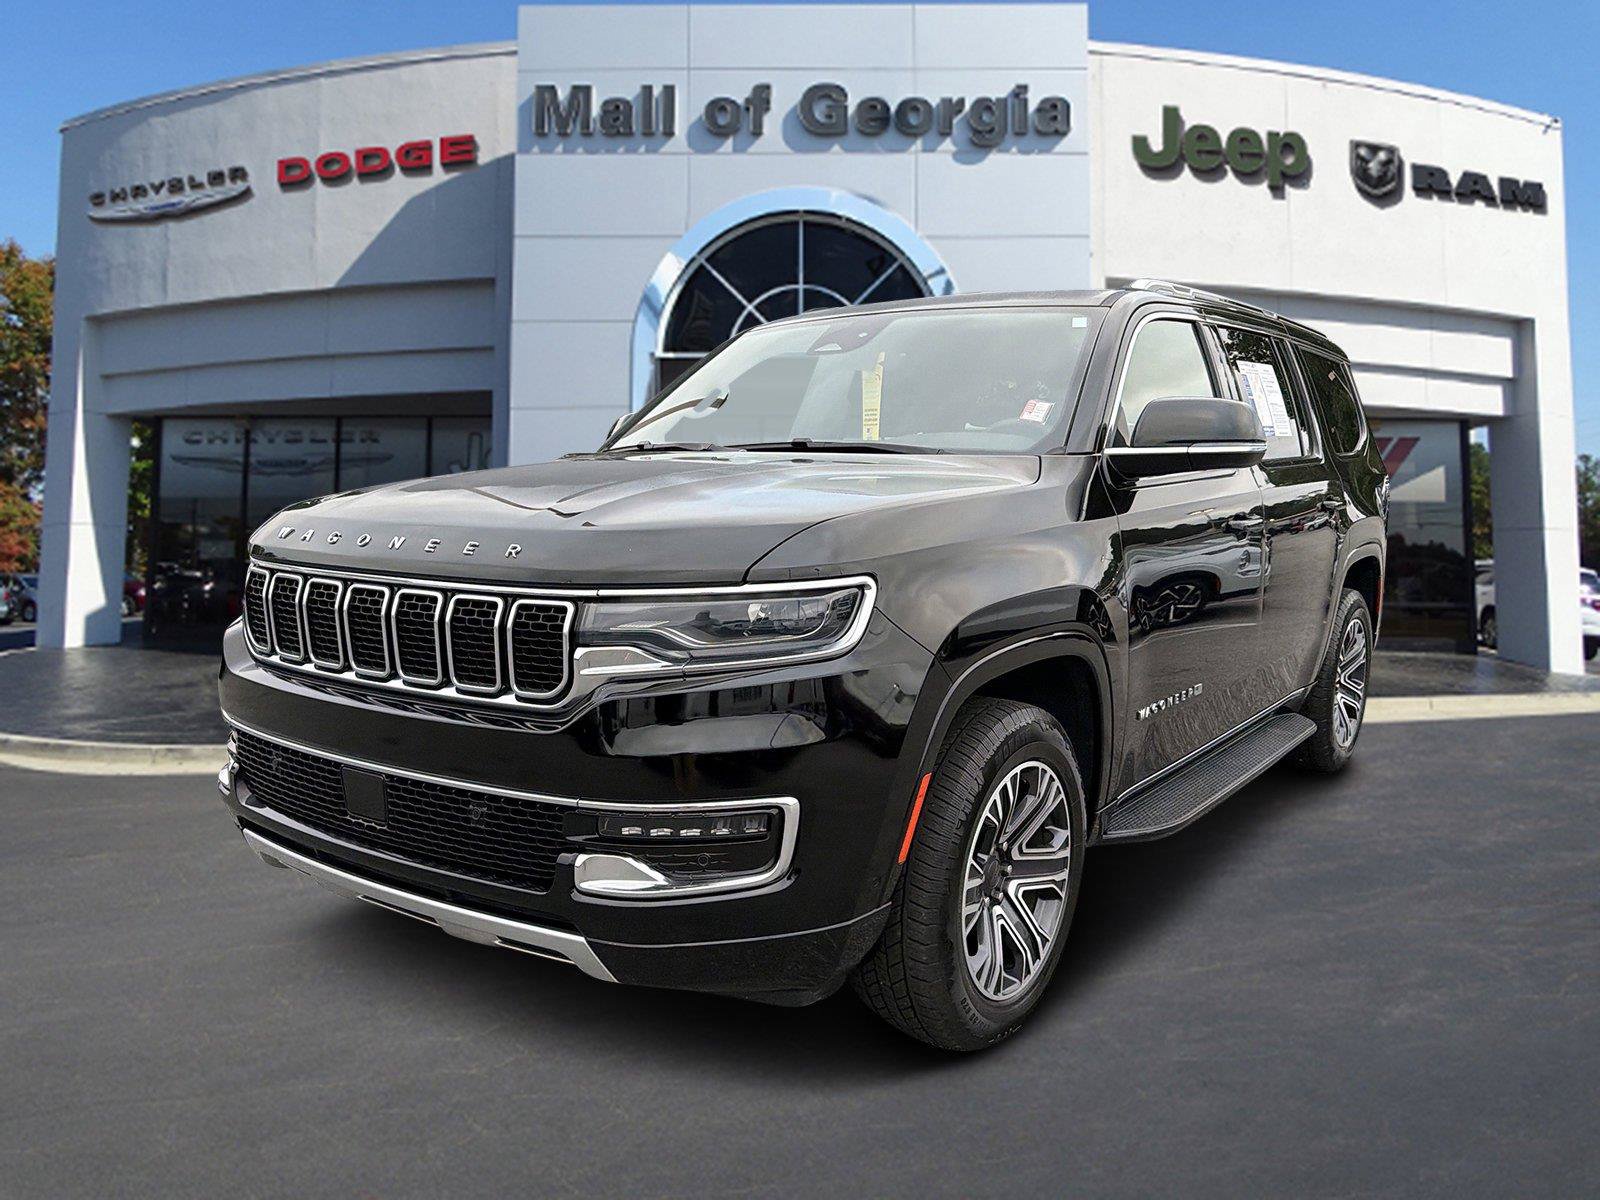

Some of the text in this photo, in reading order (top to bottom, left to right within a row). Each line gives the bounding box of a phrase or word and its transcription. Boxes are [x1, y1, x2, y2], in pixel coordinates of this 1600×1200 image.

[531, 83, 1072, 148] Mall of Georgia
[277, 134, 477, 189] DODGE
[1131, 104, 1310, 193] Jeep
[89, 166, 249, 207] CHRYSLER
[1411, 163, 1547, 212] RAM
[277, 526, 523, 559] WAGONEER
